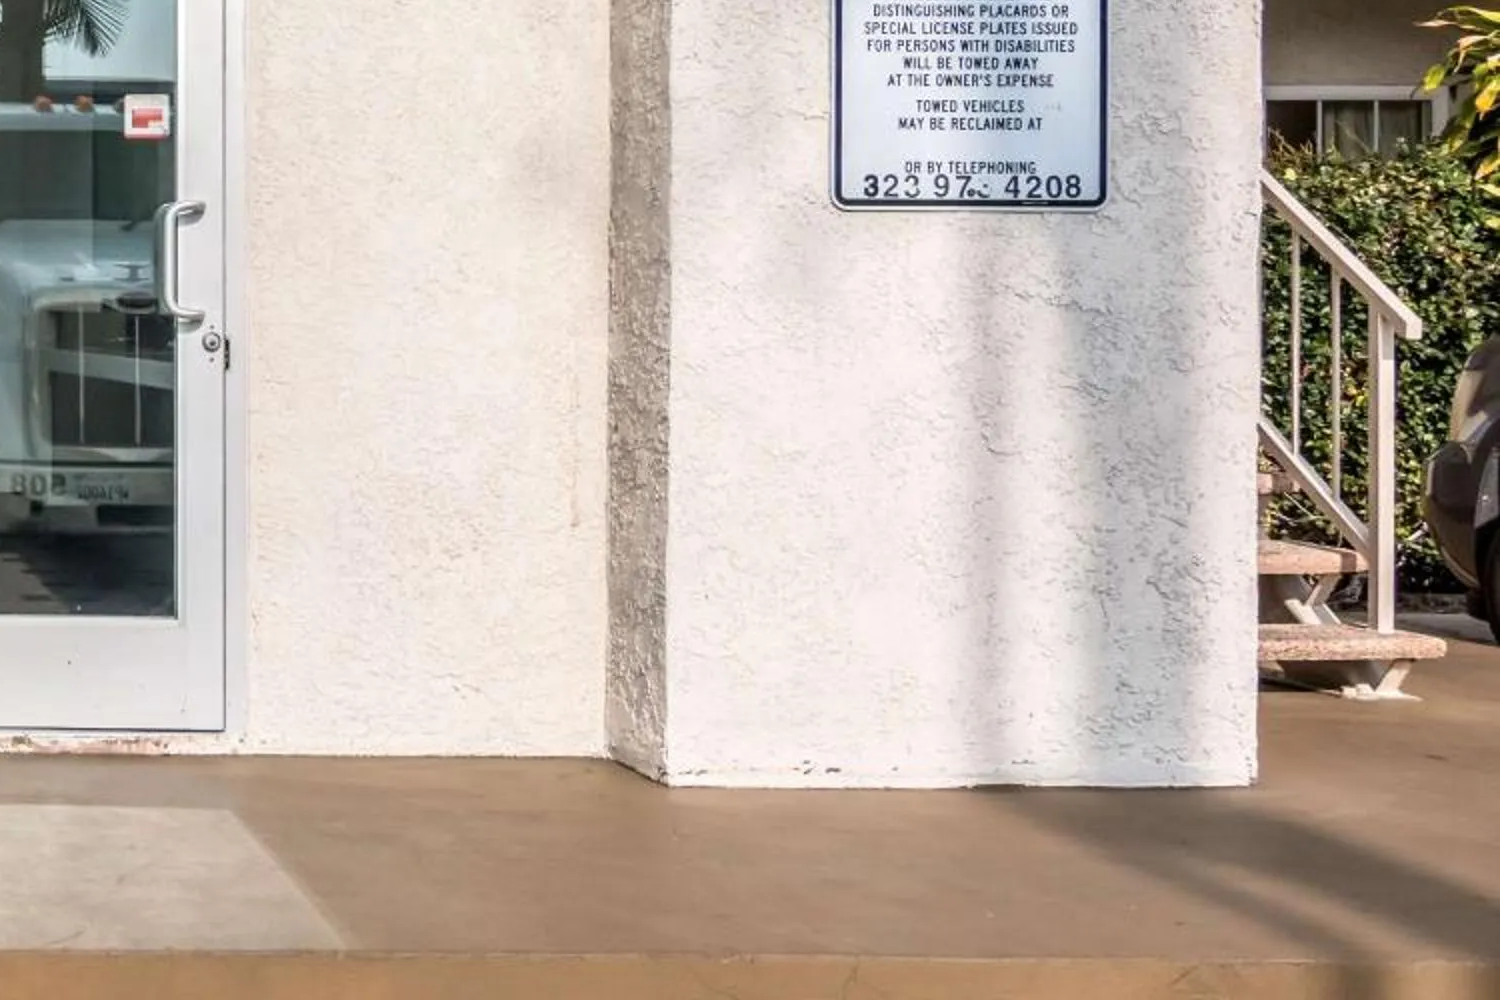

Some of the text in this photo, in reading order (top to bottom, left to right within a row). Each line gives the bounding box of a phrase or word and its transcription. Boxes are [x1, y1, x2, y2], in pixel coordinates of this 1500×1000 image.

[873, 5, 1070, 18] DISTINGUISHING PLACARDS OR
[864, 22, 1079, 35] SPECIAL LICENSE PLATES ISSUED
[867, 40, 1076, 53] FOR PERSONS WITH DISABILITIES
[903, 57, 1040, 70] WILL BE TOWED AWAY
[888, 74, 1055, 88] AT THE OWNER'S EXPENSE
[916, 100, 1026, 113] TOWED VEHICLES
[898, 118, 1044, 132] MAY BE RECLAIMED AT
[905, 162, 1037, 175] OR BY TELEPHONING
[863, 175, 922, 199] 323
[1004, 175, 1083, 199] 4208
